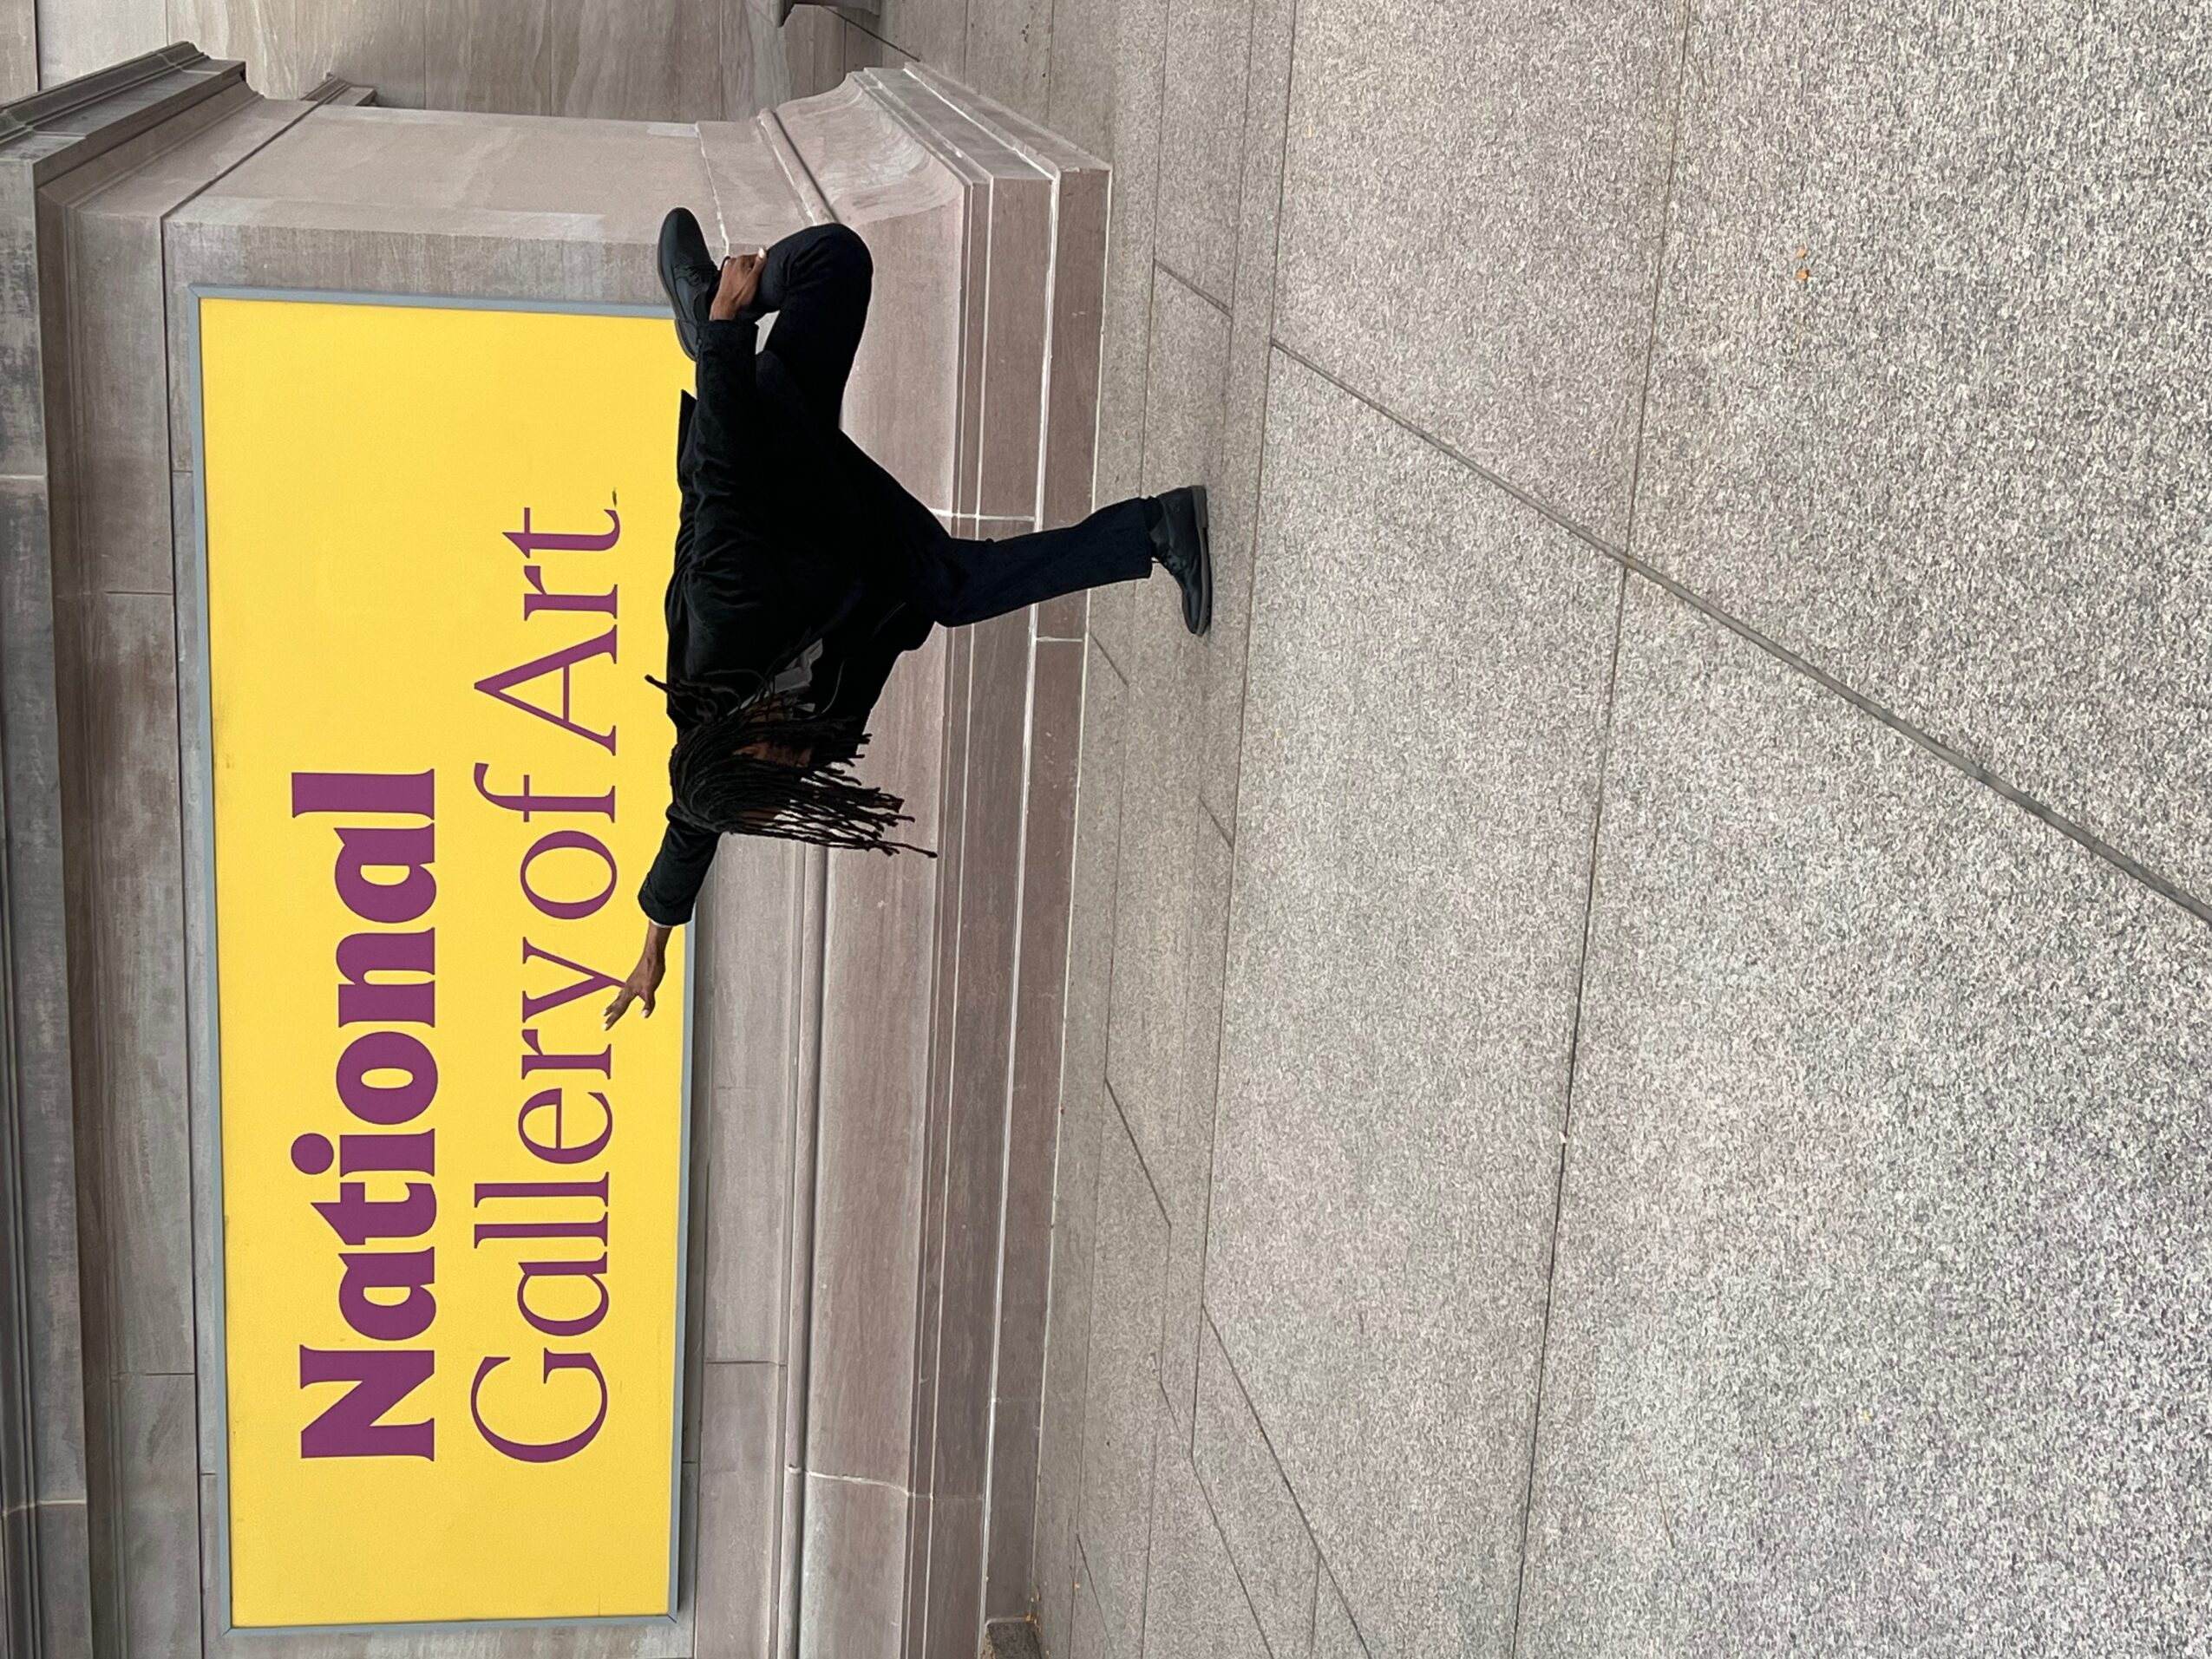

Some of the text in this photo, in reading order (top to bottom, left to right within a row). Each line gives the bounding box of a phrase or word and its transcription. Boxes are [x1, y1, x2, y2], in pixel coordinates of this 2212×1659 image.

[291, 768, 438, 1462] National
[469, 506, 628, 1464] Gallery of Art
